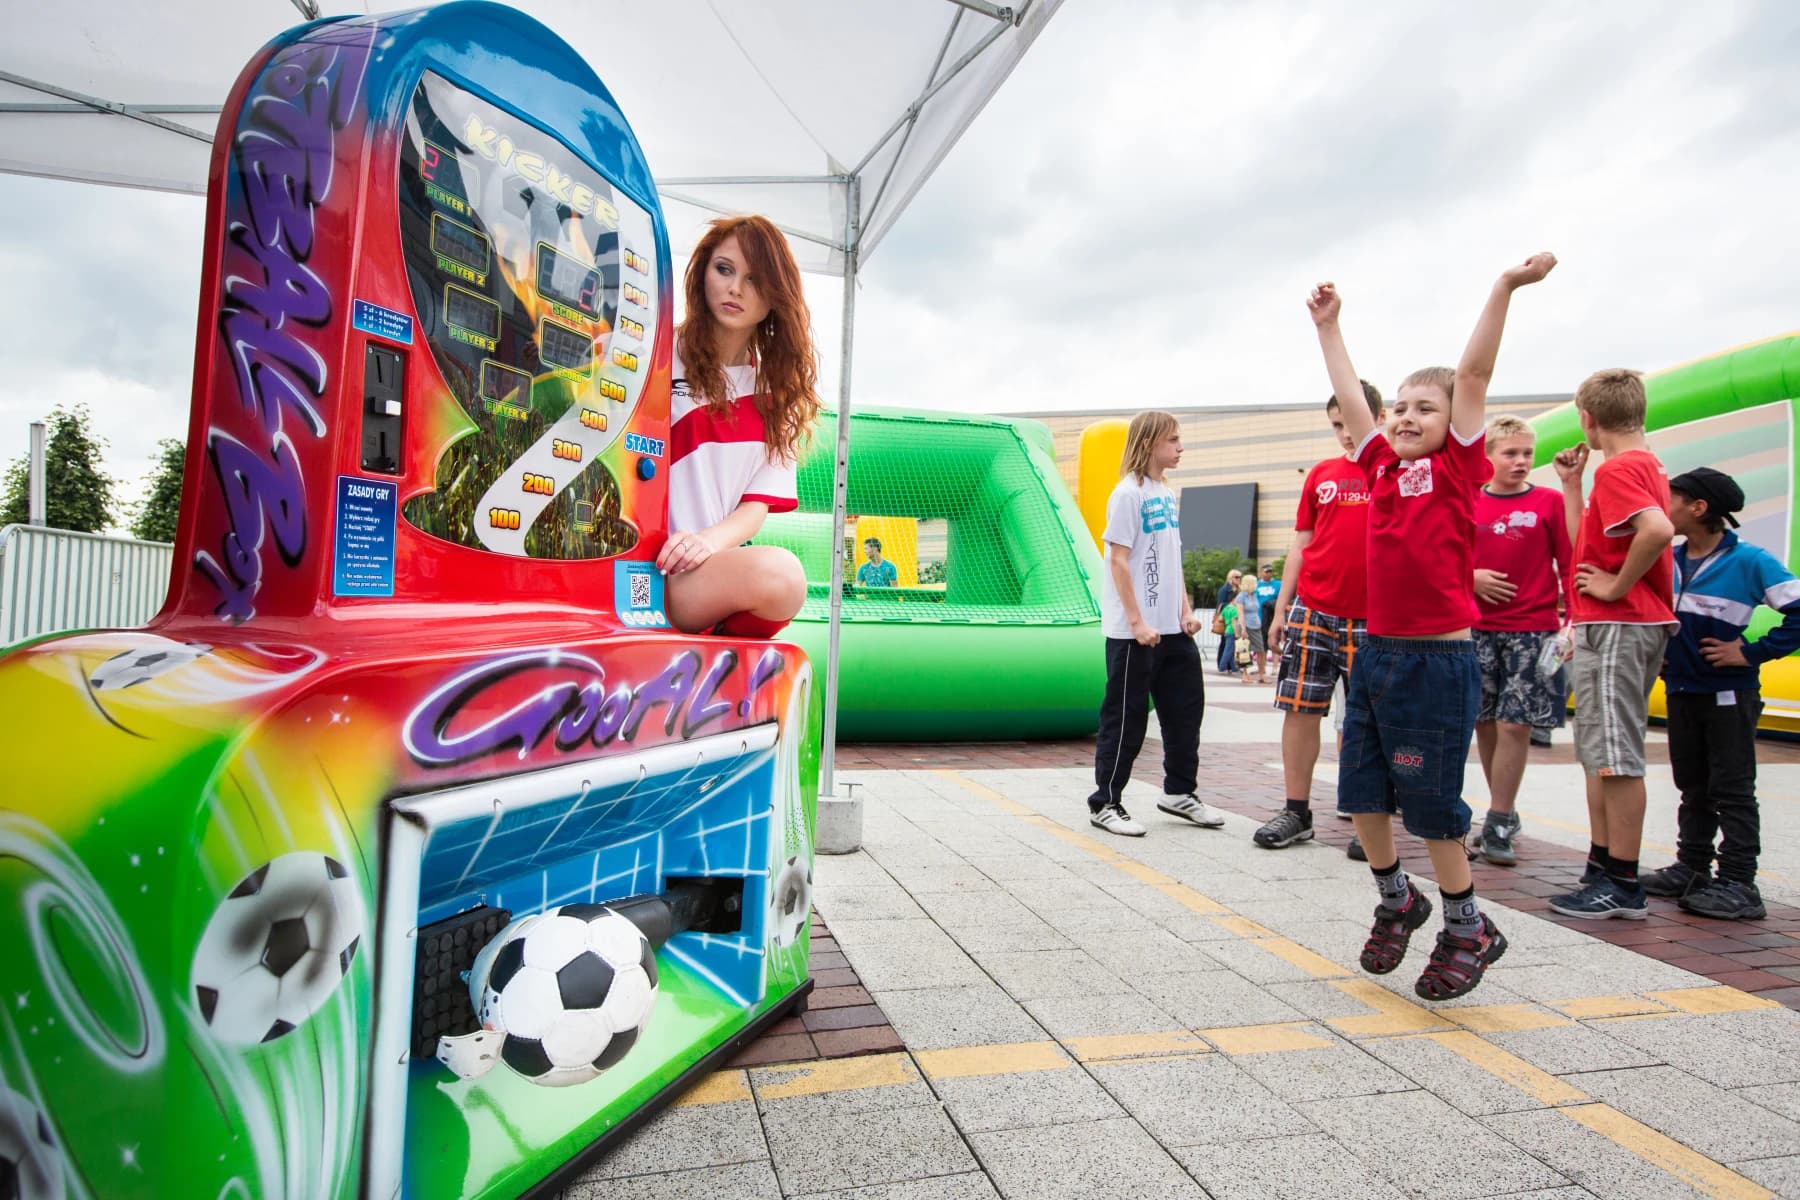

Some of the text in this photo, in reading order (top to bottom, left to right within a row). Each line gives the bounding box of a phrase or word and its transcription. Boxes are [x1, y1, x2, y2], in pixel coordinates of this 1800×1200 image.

[422, 147, 440, 181] 2
[464, 115, 620, 231] KICKER
[425, 183, 473, 218] PLAYER 1
[437, 256, 486, 287] PLAYER 2
[552, 302, 584, 325] SCORE
[448, 325, 496, 352] PLAYER 3
[600, 377, 626, 403] 500
[485, 400, 529, 422] PLAYER 4
[580, 407, 608, 432] 400
[552, 438, 582, 463] 300
[624, 432, 665, 458] START
[347, 484, 390, 500] ZASADY GRY
[522, 472, 555, 496] 200
[489, 507, 521, 530] 100
[1393, 752, 1424, 768] HOT
